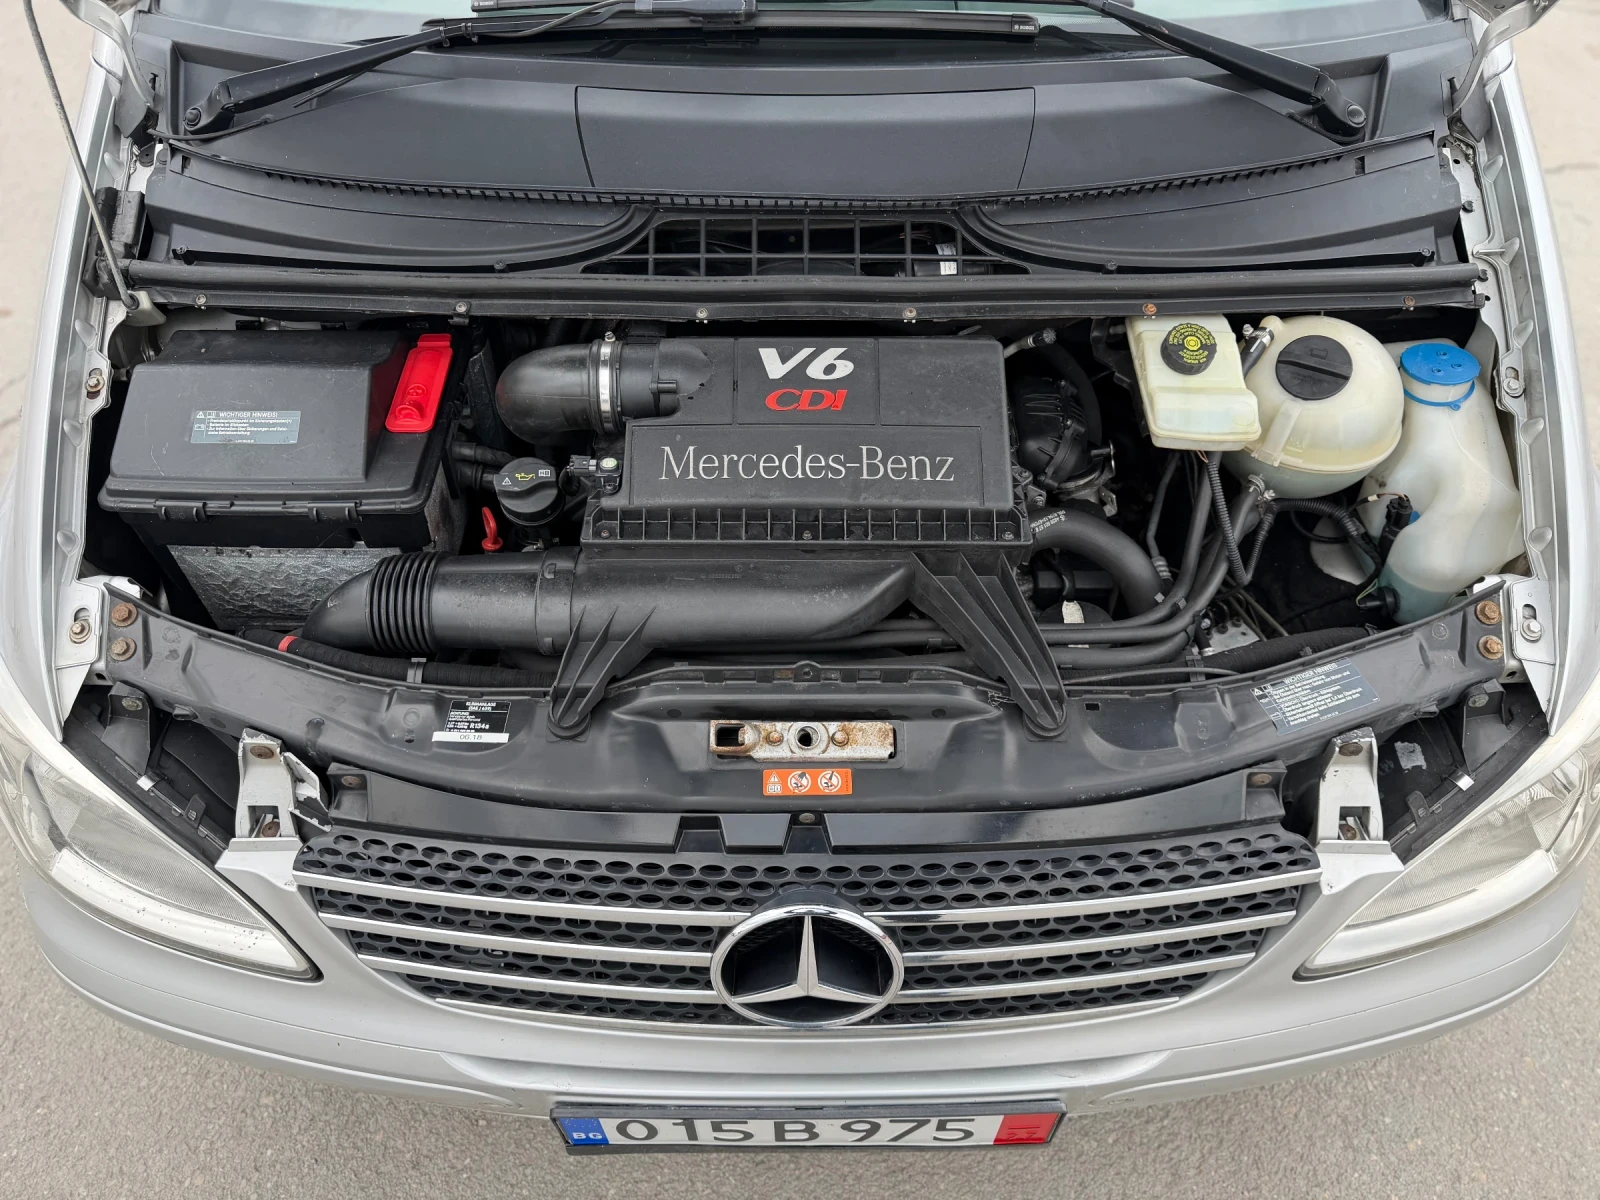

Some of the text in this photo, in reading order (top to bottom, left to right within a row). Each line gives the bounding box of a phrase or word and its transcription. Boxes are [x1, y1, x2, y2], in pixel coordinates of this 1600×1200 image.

[758, 347, 854, 380] V6
[765, 388, 847, 411] CDI
[659, 445, 955, 481] Mercedes-Benz
[773, 1120, 819, 1142] B
[840, 1118, 975, 1142] 975
